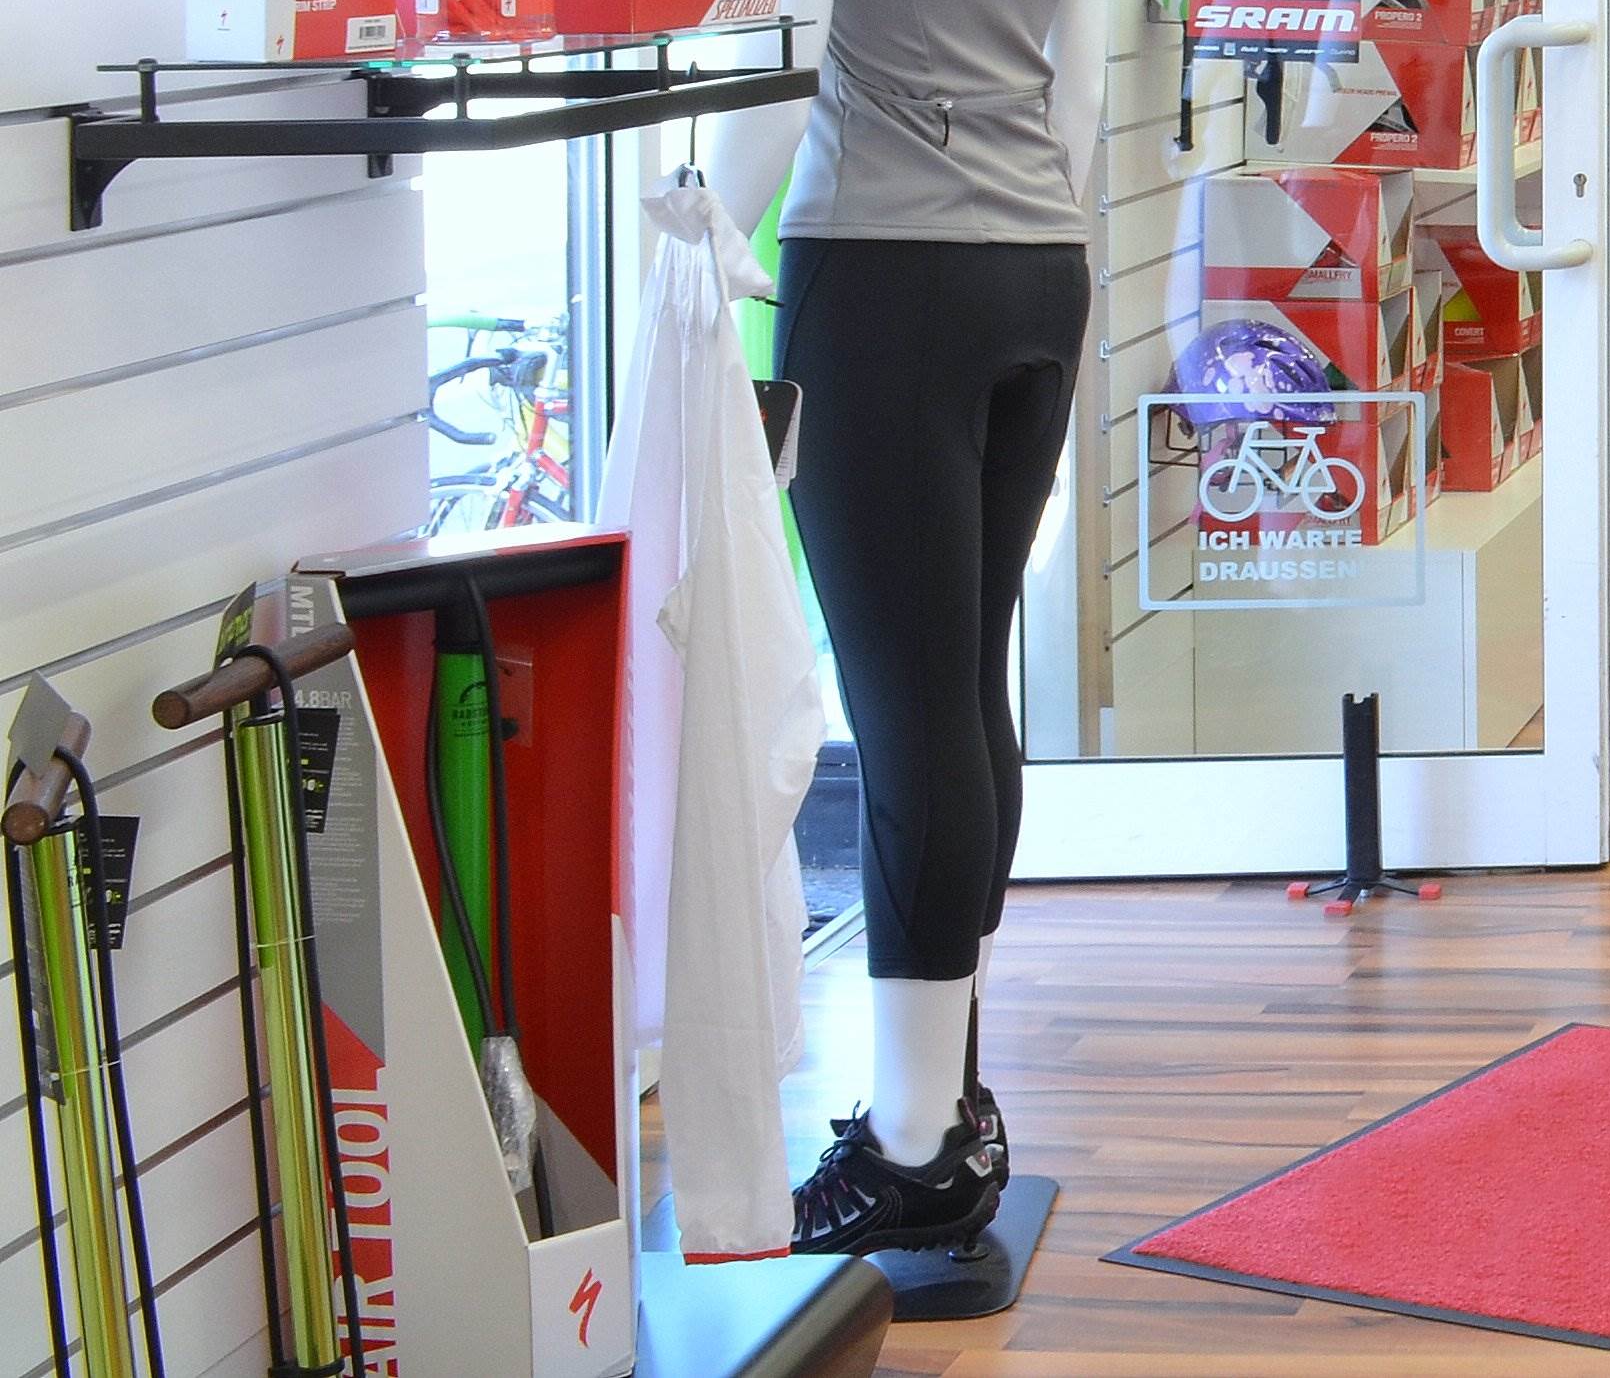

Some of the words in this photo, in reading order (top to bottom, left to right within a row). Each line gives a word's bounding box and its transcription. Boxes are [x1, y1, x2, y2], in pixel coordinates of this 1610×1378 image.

[1194, 5, 1355, 32] SRAM
[1415, 12, 1423, 21] 2
[1411, 134, 1418, 143] 2
[1199, 531, 1249, 550] ICH
[1259, 529, 1362, 550] WARTE
[1200, 560, 1361, 582] DRAUSSEN
[330, 1068, 392, 1252] TOOL
